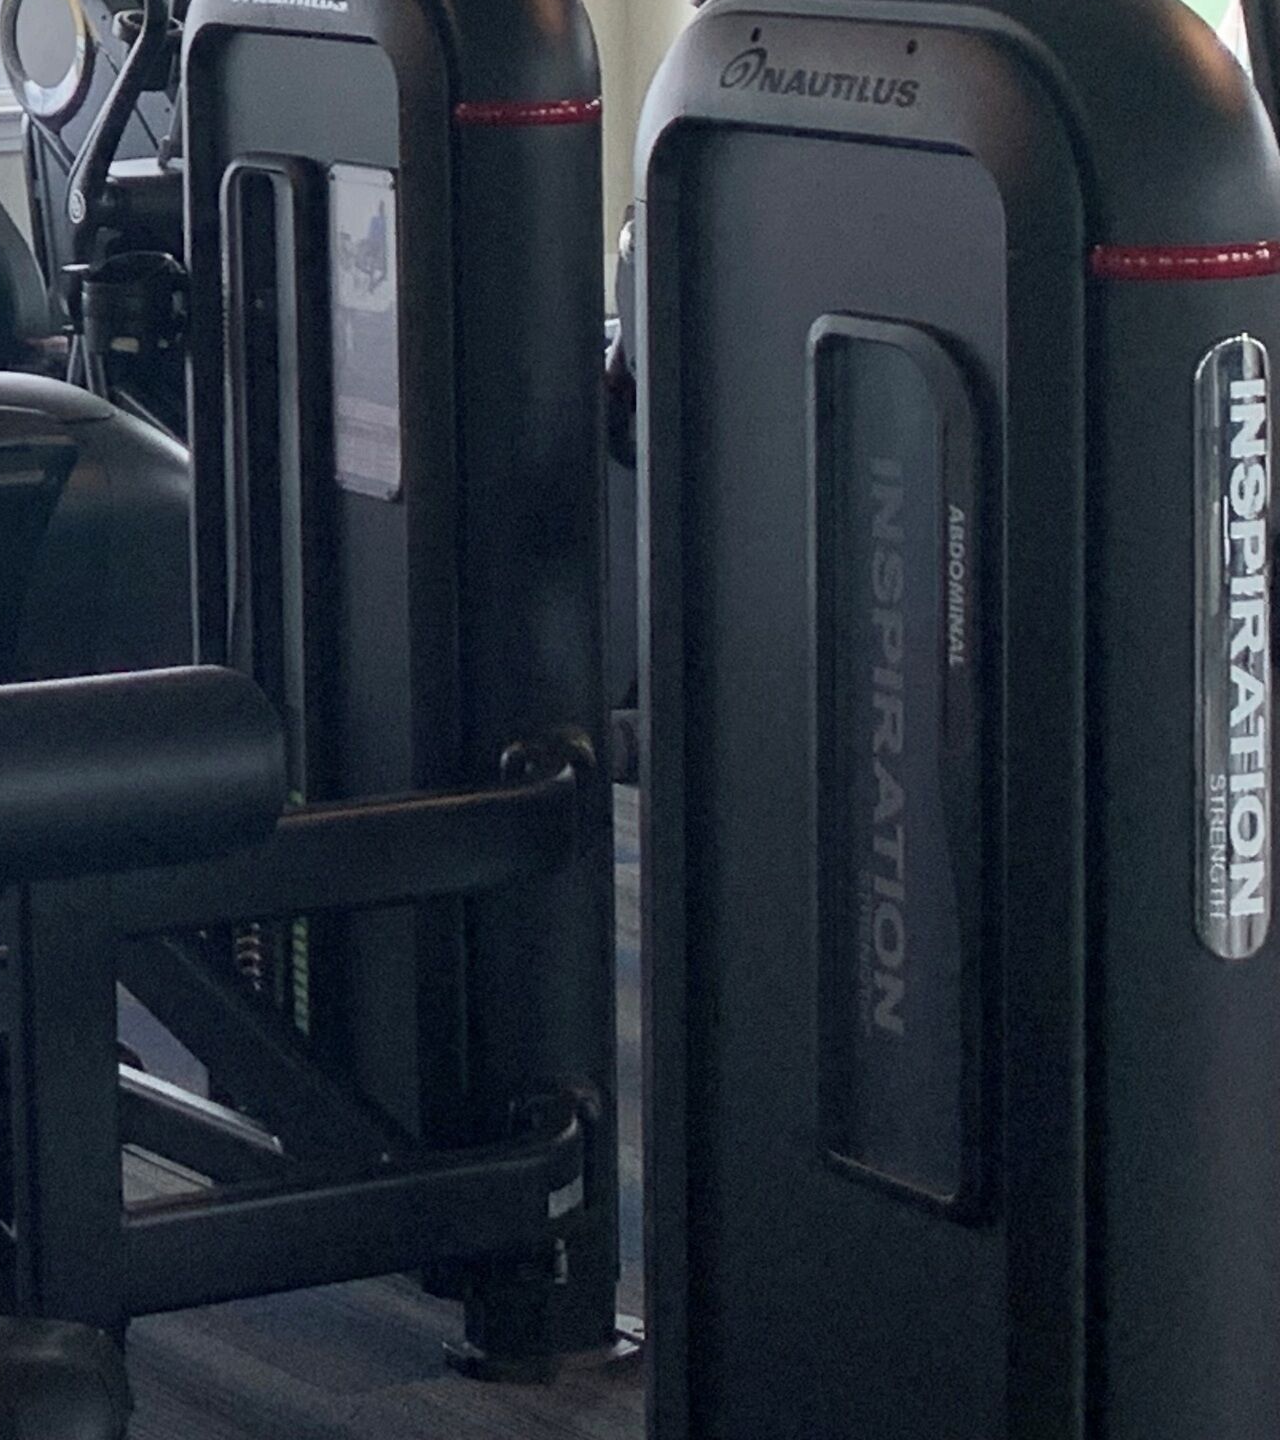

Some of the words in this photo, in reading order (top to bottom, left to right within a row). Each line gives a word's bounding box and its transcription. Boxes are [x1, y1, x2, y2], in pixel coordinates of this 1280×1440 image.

[759, 67, 920, 108] NAUTILUS
[949, 504, 965, 666] ABDOMINAL
[1230, 379, 1266, 916] INSPIRATION
[871, 457, 905, 1037] INSPIRATION
[1209, 774, 1227, 918] STRENGTH
